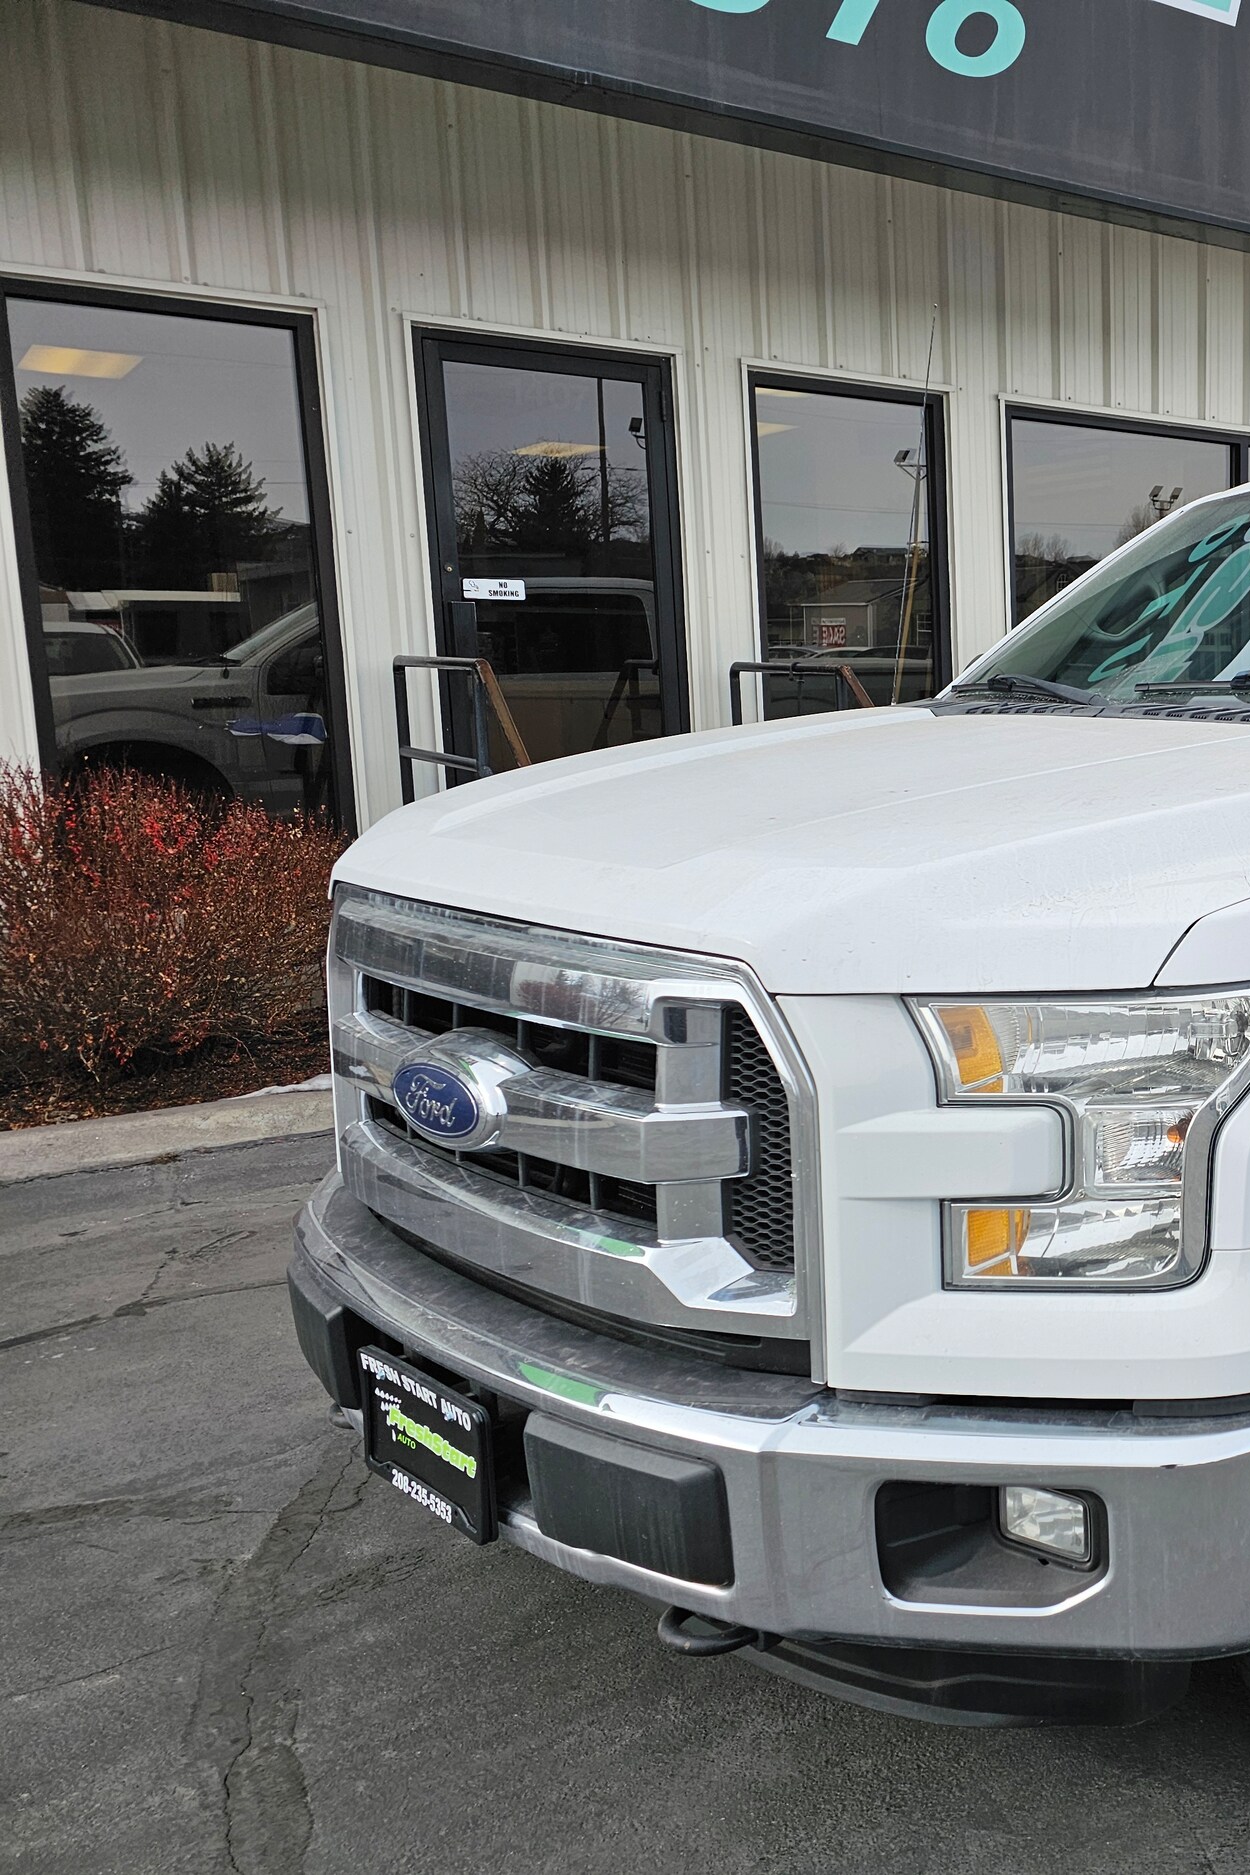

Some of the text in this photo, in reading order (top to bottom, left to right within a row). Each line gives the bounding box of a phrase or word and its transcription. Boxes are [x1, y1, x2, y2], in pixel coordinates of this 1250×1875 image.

[488, 589, 520, 598] SMOKING
[498, 581, 508, 589] NO
[405, 1073, 458, 1128] Ford
[359, 1352, 472, 1433] FRESH START AUTO
[396, 1433, 417, 1451] AUTO
[391, 1468, 453, 1525] 208-235-5353
